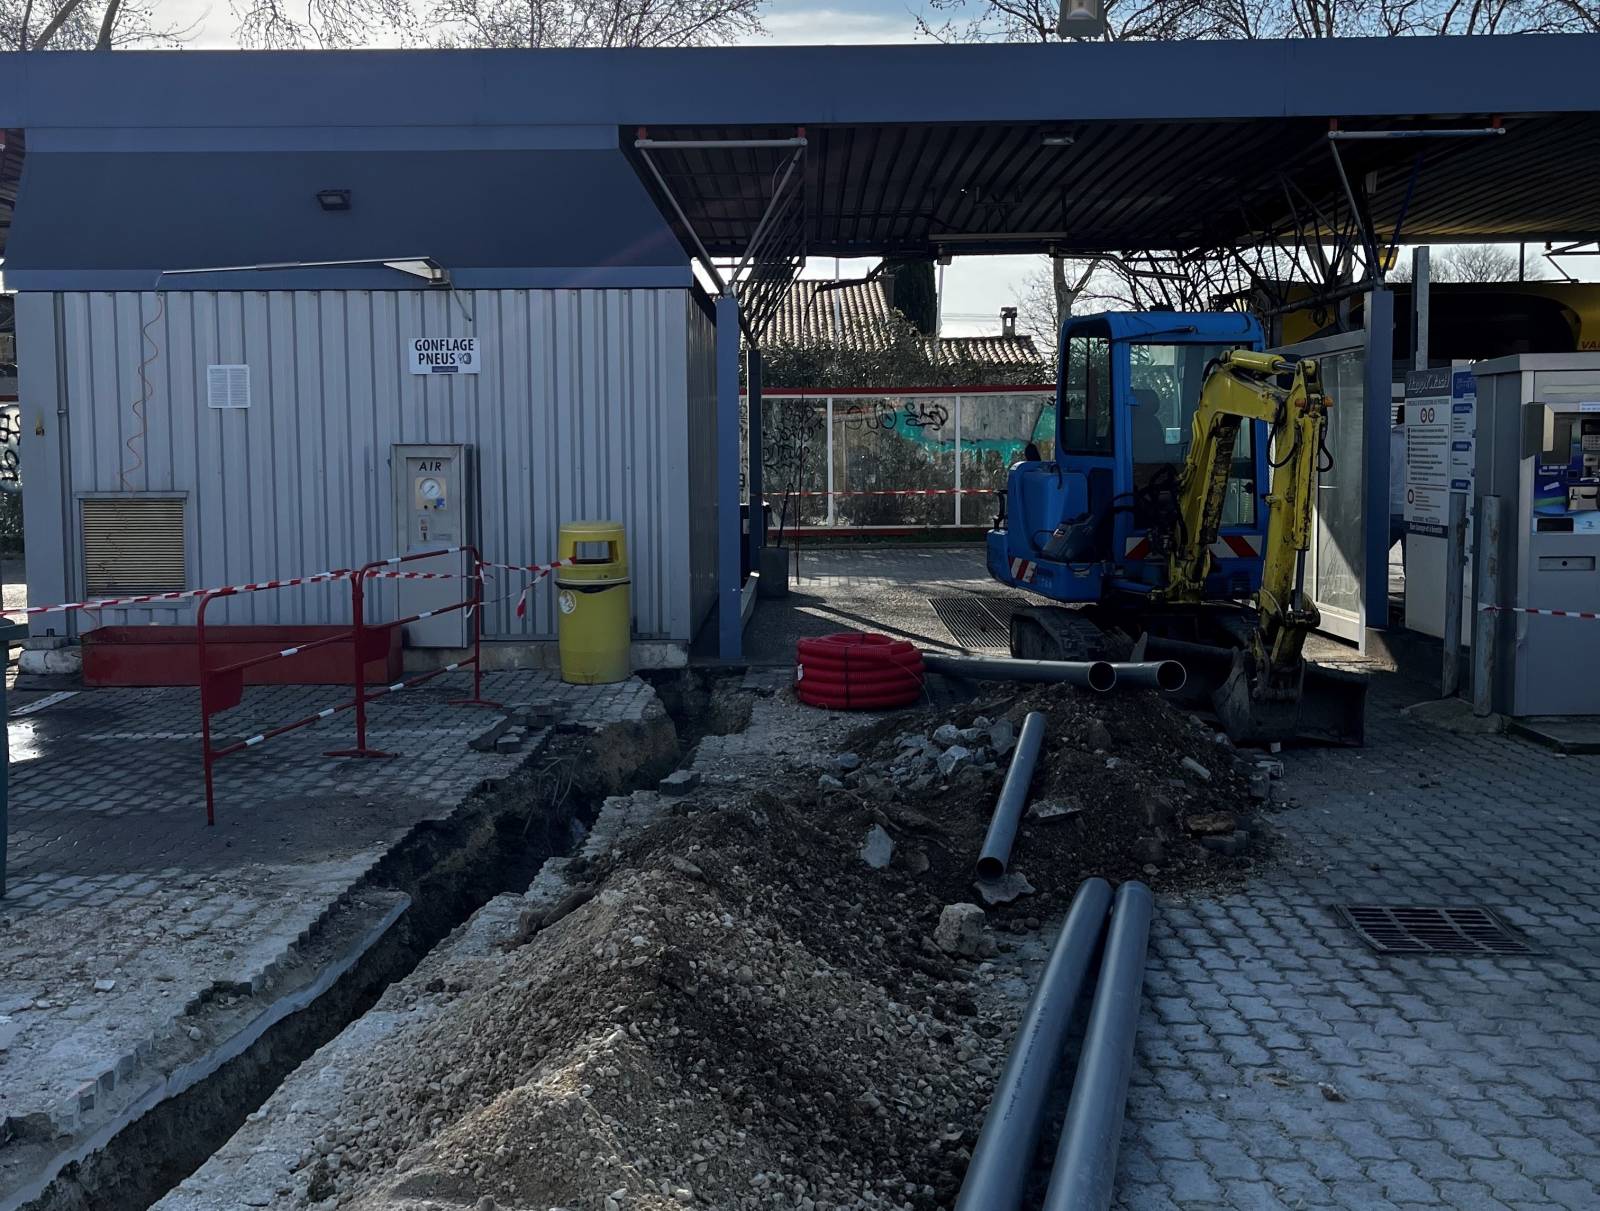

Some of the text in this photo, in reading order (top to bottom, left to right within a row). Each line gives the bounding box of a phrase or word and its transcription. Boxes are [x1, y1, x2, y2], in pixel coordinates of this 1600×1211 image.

[415, 339, 474, 351] GONFLAGE
[418, 353, 455, 365] PNEUS
[419, 462, 442, 471] AIR
